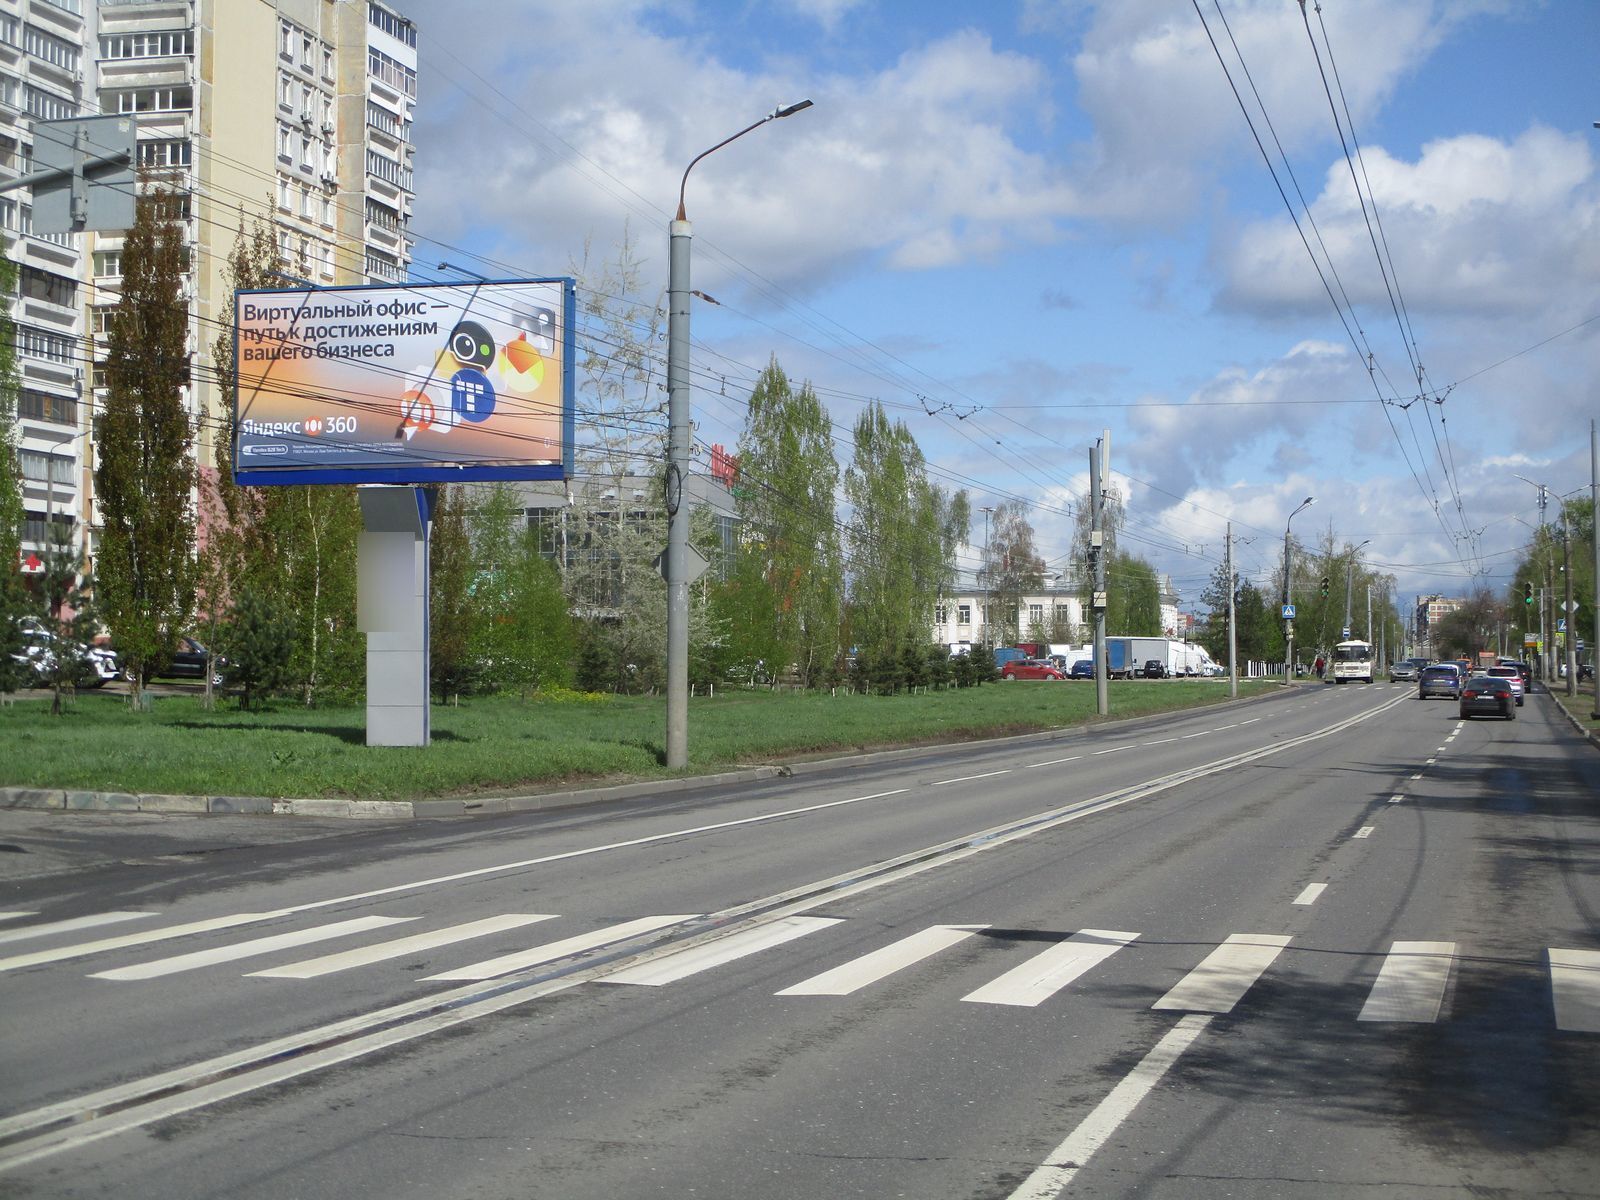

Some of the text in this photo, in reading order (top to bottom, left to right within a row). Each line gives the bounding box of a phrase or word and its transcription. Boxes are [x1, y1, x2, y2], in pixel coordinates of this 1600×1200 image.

[244, 300, 373, 324] Виртуальный
[376, 298, 427, 319] офис
[243, 321, 438, 344] путь к достижениям
[243, 342, 395, 361] вашего бизнеса
[242, 416, 357, 437] Яндекс 360
